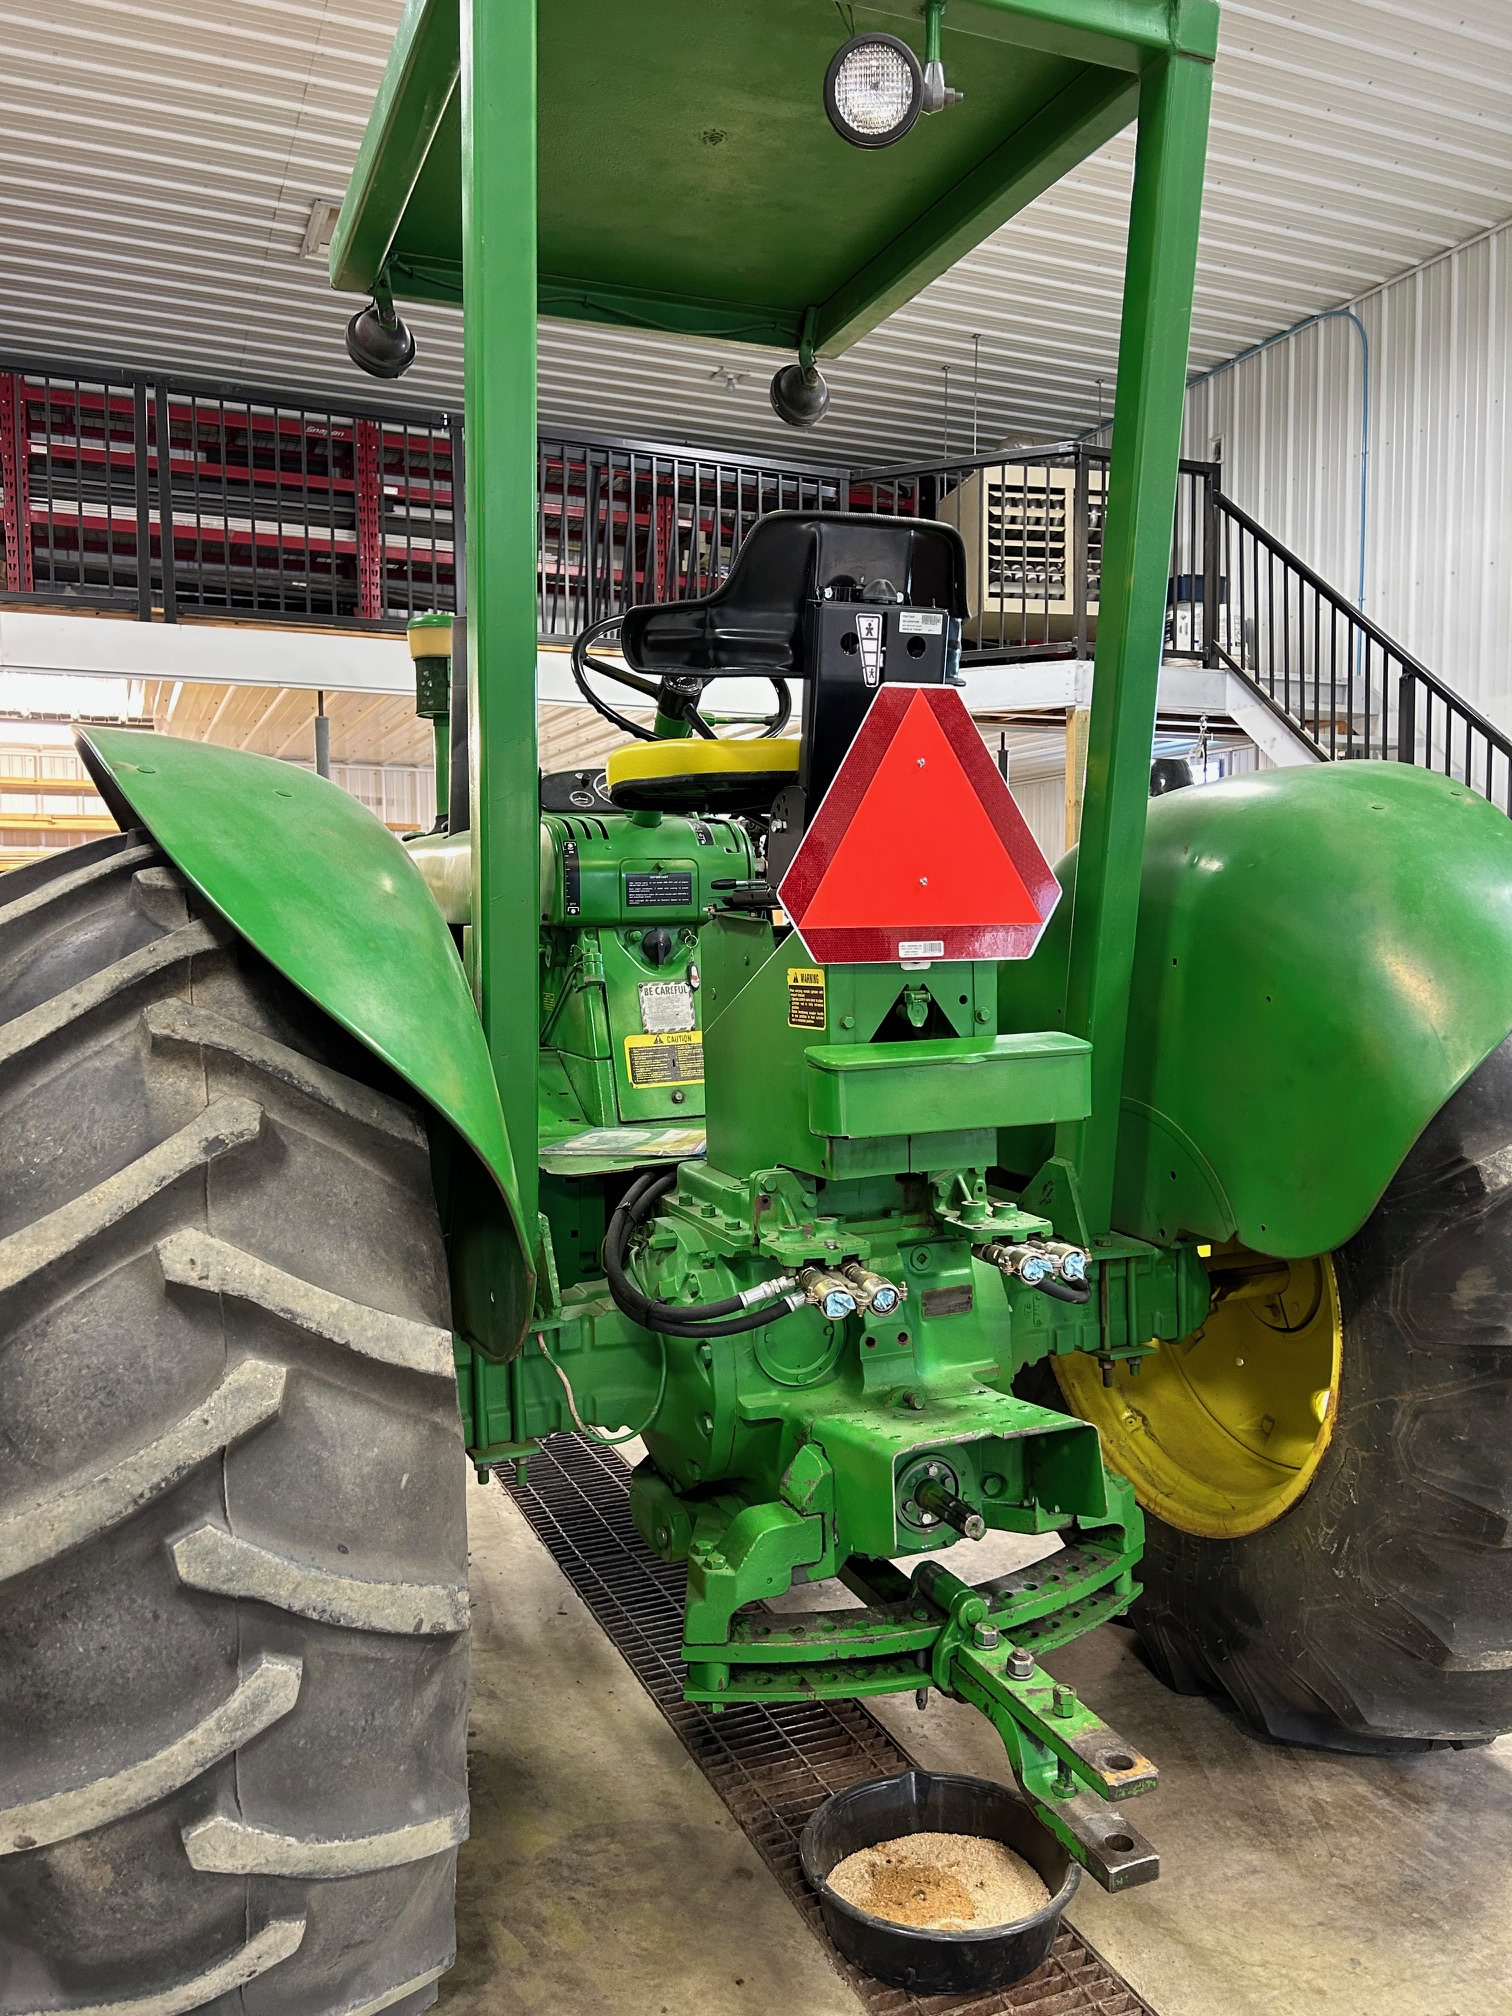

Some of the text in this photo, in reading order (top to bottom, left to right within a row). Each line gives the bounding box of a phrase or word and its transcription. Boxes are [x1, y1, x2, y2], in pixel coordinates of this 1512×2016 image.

[306, 425, 345, 437] Snapon
[800, 973, 819, 984] WARNING
[644, 985, 688, 996] BE CAREFUL
[666, 1035, 692, 1044] CAUTION
